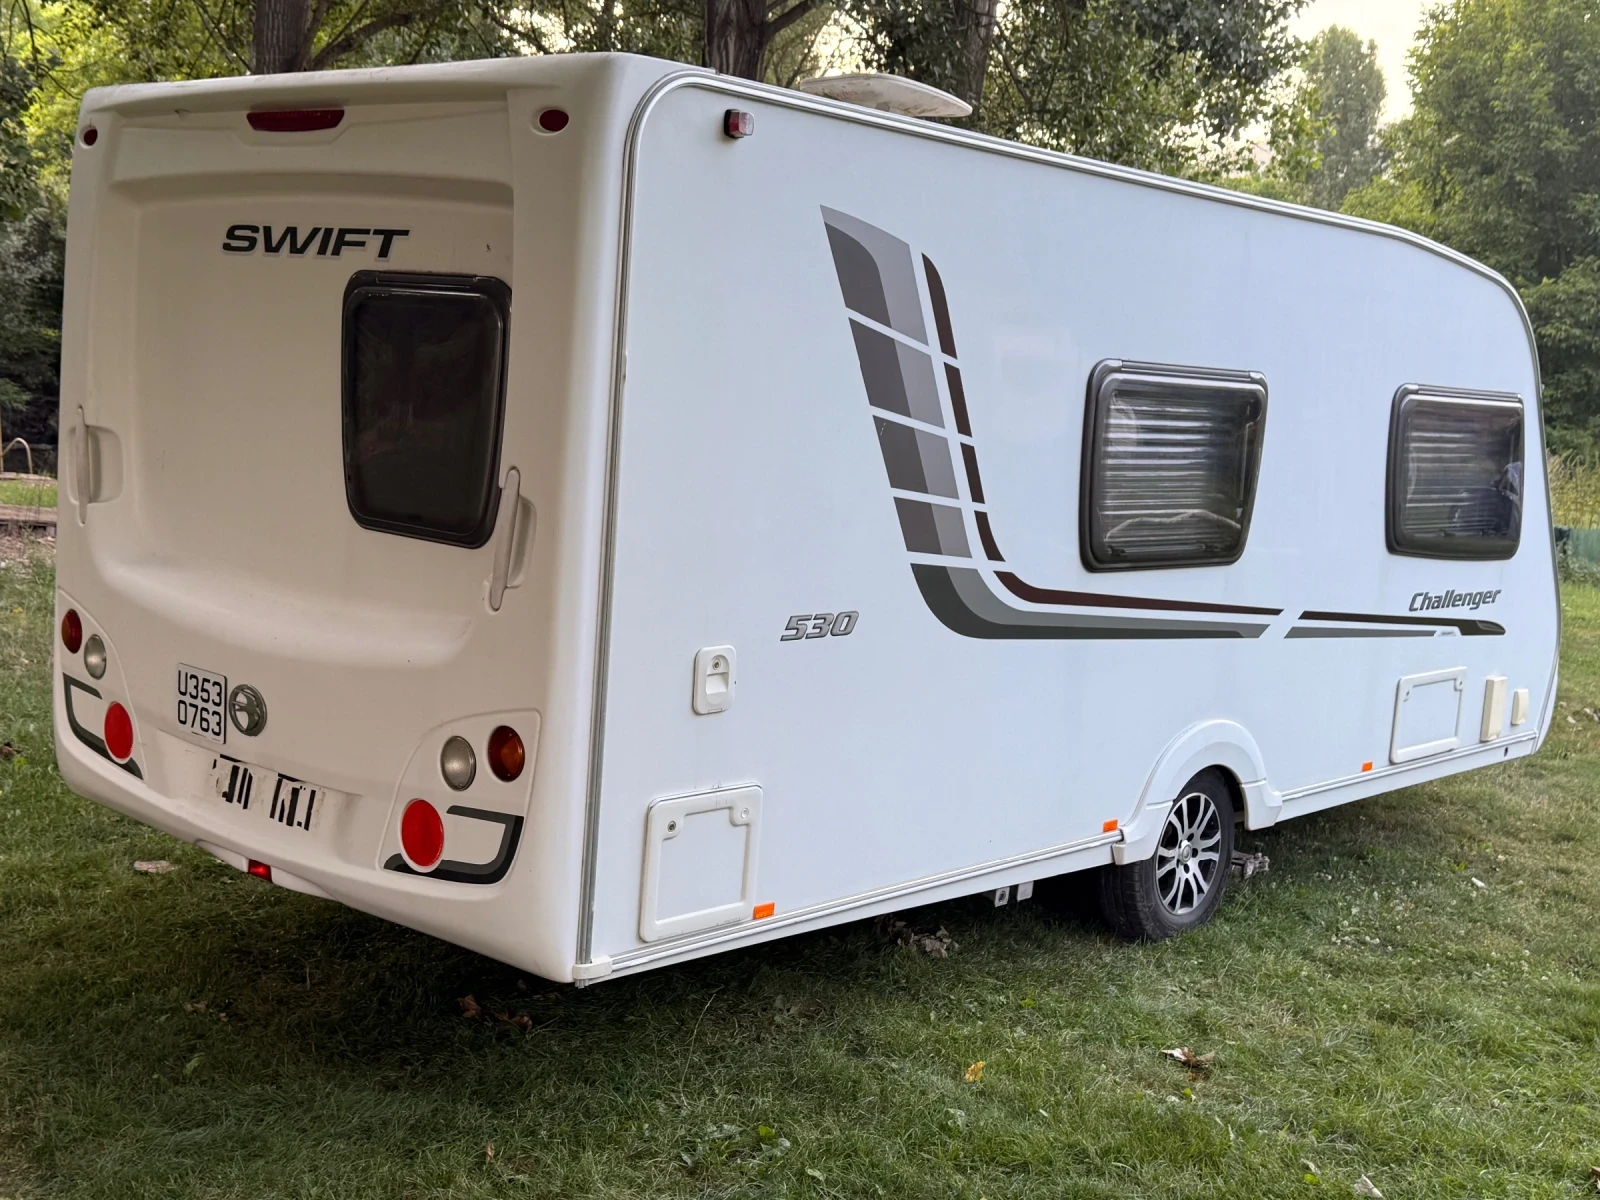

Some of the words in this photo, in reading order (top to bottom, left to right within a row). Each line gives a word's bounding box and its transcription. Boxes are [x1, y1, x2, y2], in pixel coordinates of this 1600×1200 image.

[222, 224, 410, 259] SWIFT
[1408, 589, 1502, 612] Challenger
[779, 610, 860, 642] 530
[178, 669, 222, 707] U353
[178, 699, 222, 736] 0763
